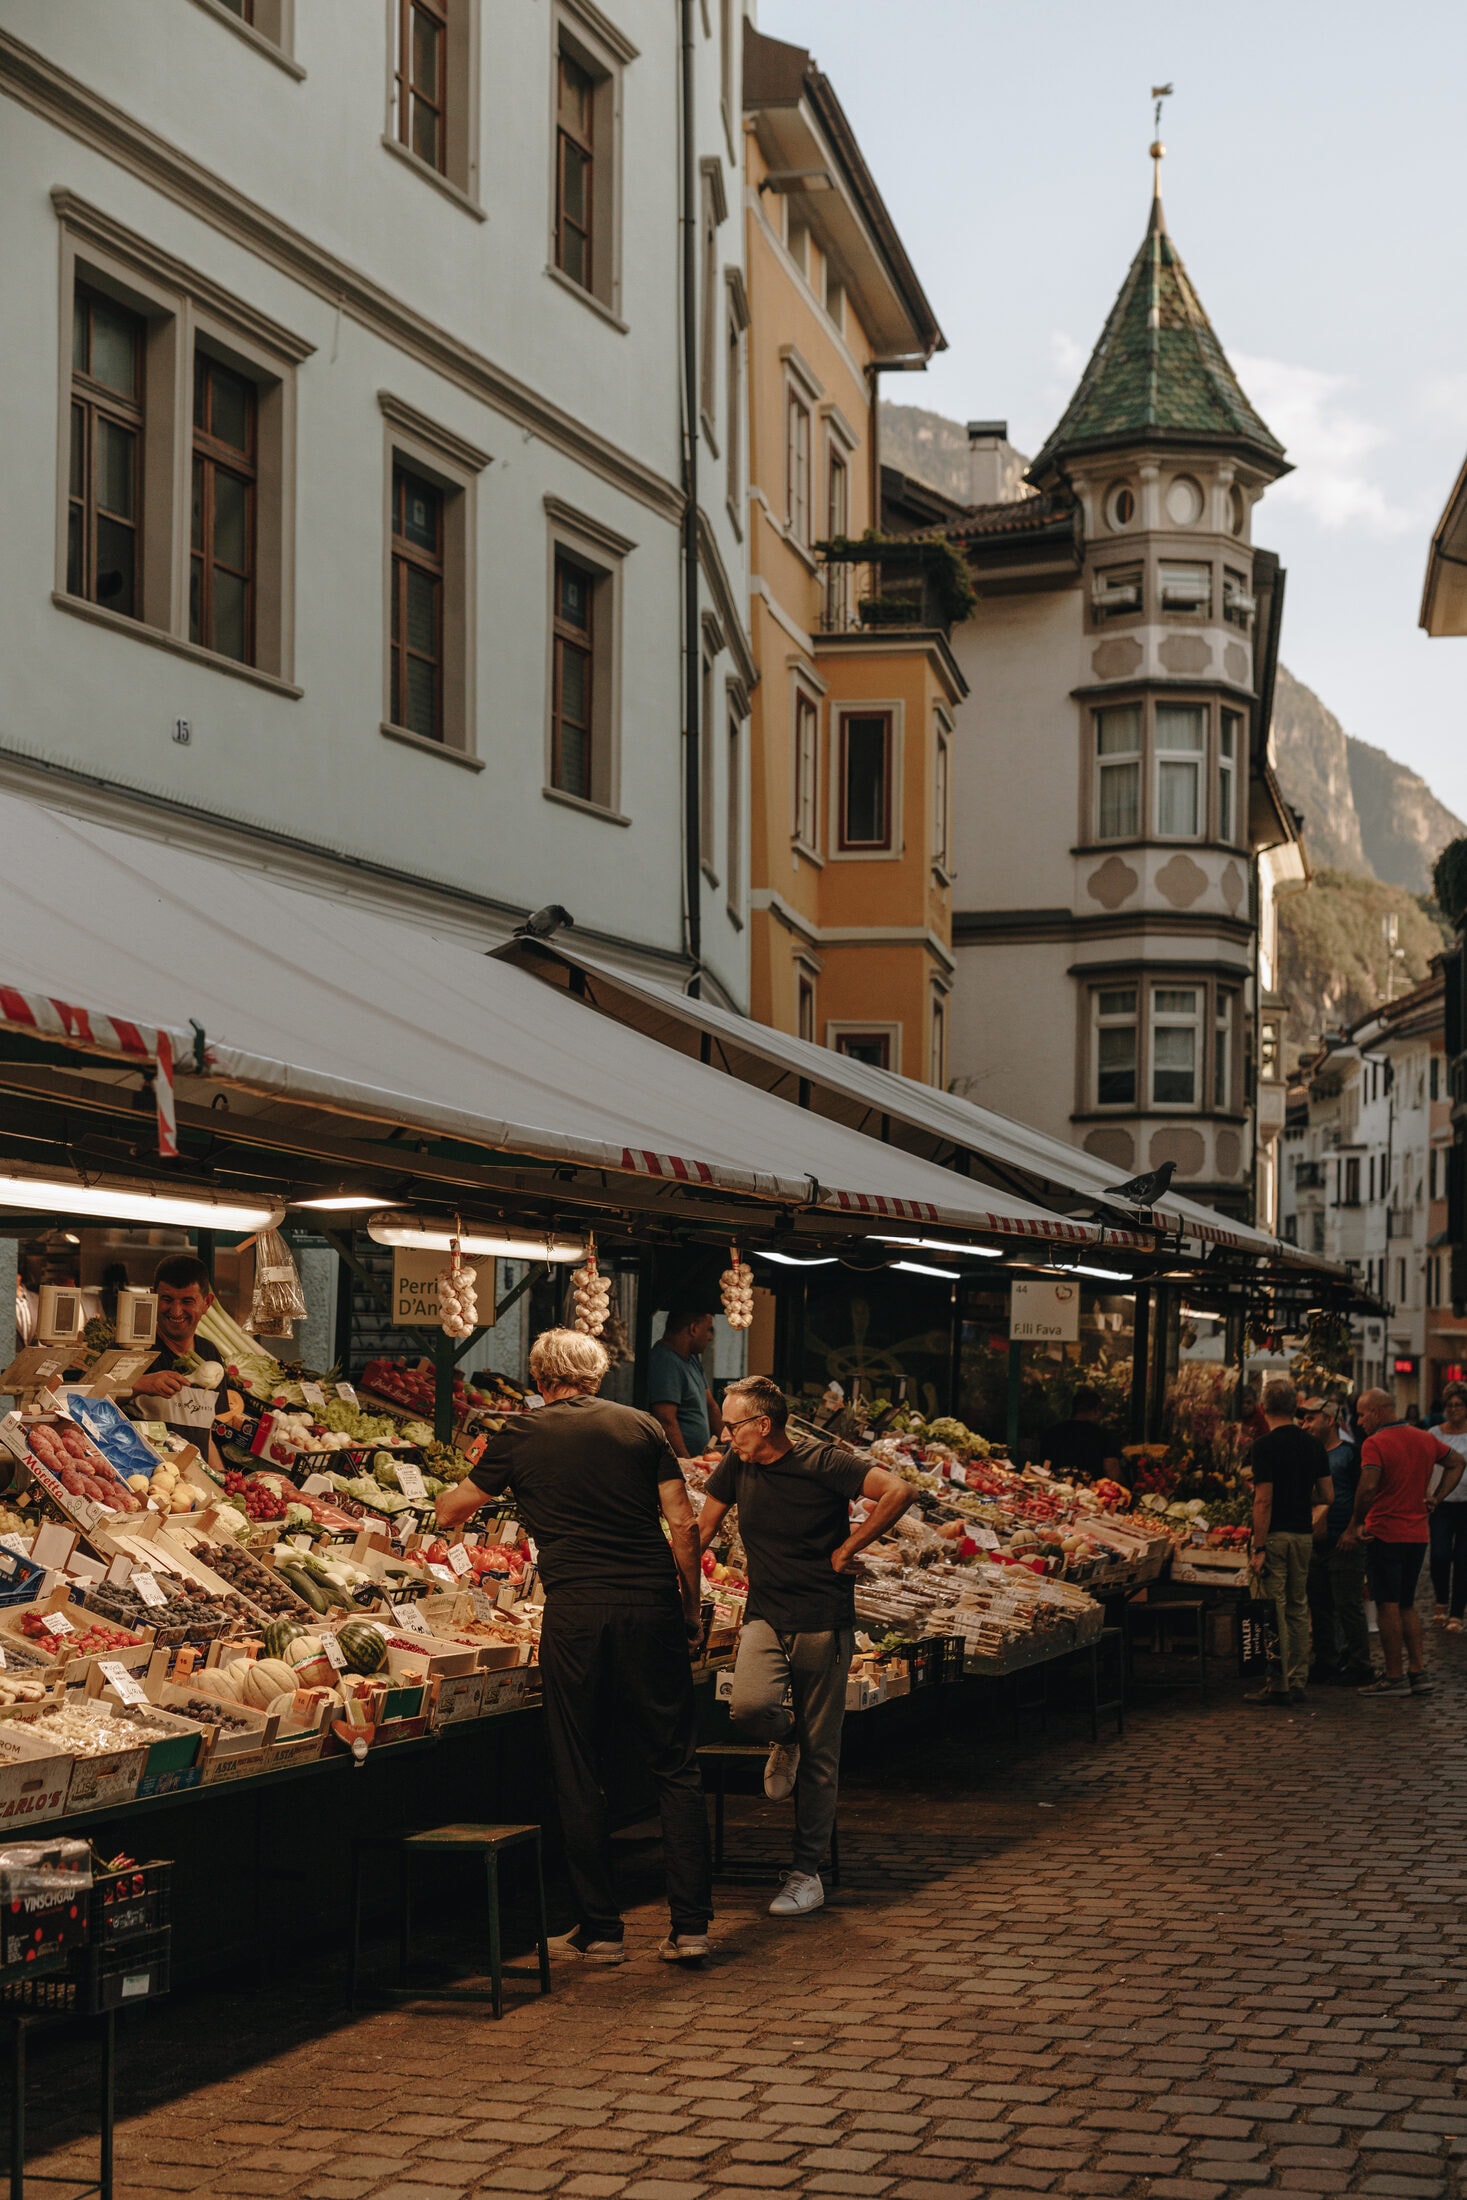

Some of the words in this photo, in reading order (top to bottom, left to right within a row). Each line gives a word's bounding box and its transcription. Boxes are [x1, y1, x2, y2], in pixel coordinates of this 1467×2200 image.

[176, 719, 189, 742] 15
[1015, 1285, 1028, 1294] 44
[398, 1298, 442, 1316] D'An
[1014, 1322, 1033, 1335] F.lli
[1036, 1323, 1062, 1336] Fava
[22, 1454, 64, 1500] Moretta
[1242, 1618, 1252, 1662] THALER
[214, 1760, 238, 1774] ASTA
[24, 1888, 76, 1912] VINSCHGAU
